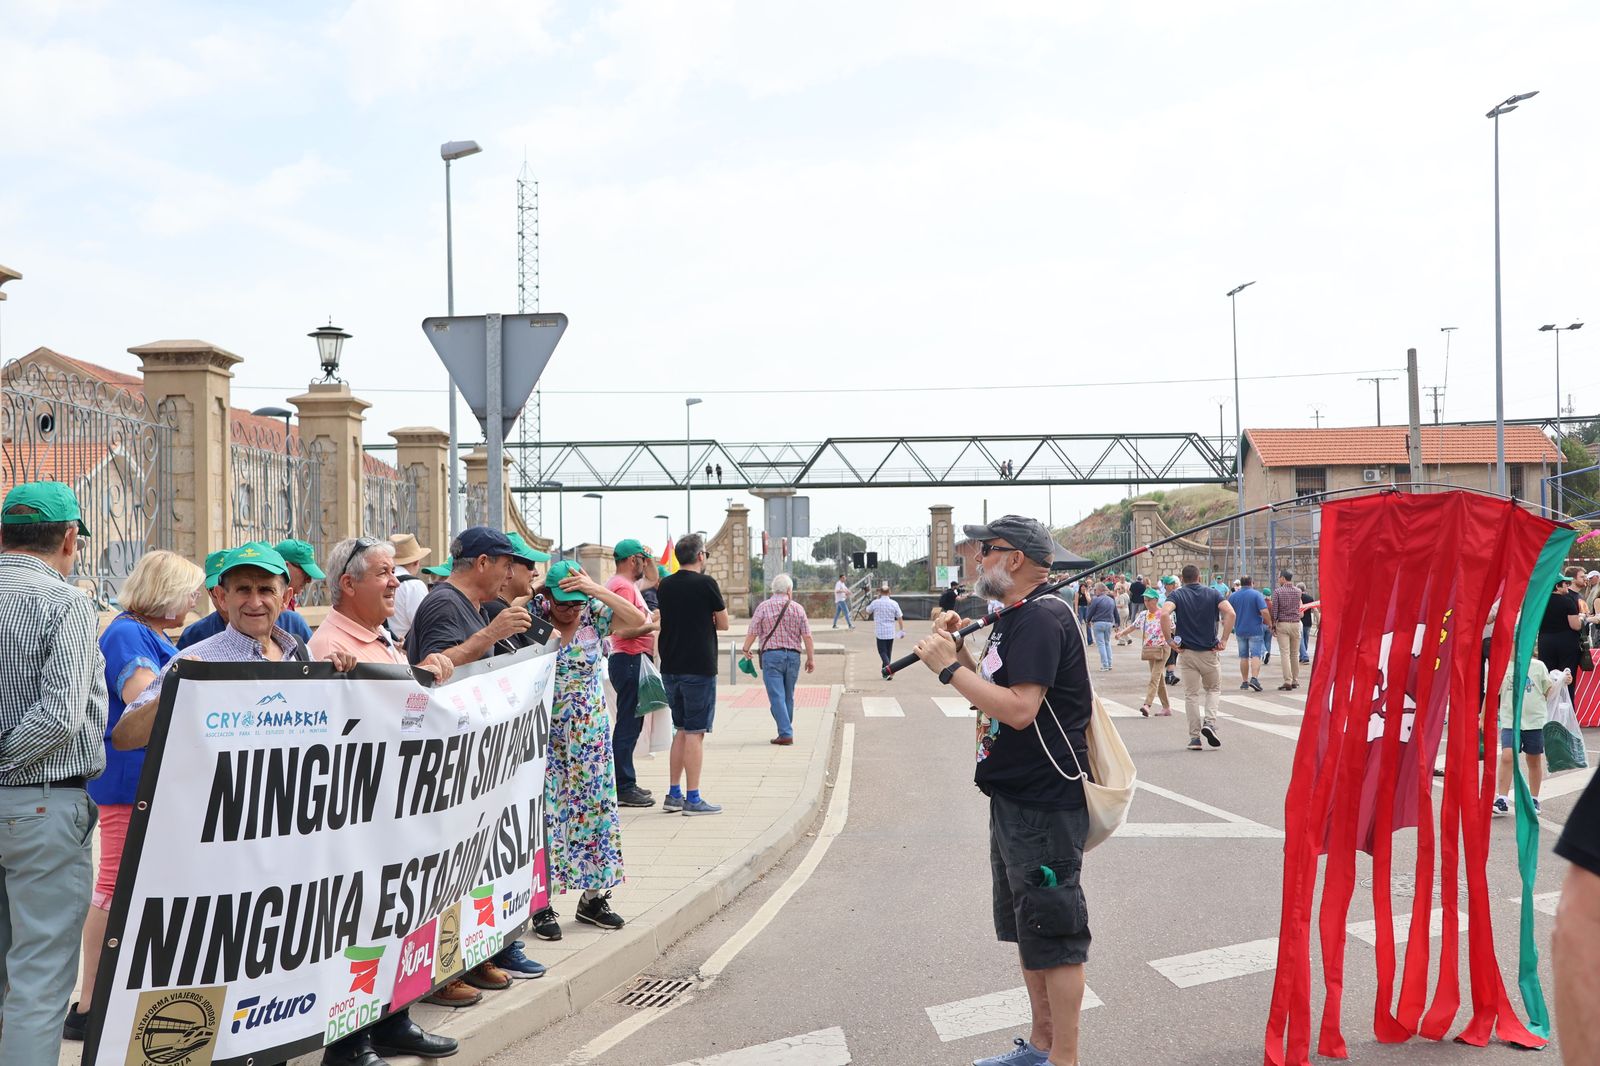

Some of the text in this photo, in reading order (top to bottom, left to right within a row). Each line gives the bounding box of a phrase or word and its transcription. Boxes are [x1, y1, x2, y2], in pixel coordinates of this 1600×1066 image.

[200, 718, 387, 843] NINGÚN
[394, 731, 476, 819] TREN
[470, 720, 509, 801] SIN
[126, 870, 364, 990] NINGUNA
[371, 811, 490, 941] ESTACIÓN
[404, 942, 432, 978] UPL
[464, 930, 484, 948] ahora
[134, 991, 216, 1041] PLATAFORMA VIAJEROS JODIDOS
[230, 992, 317, 1035] Futuro
[328, 996, 355, 1019] ahora
